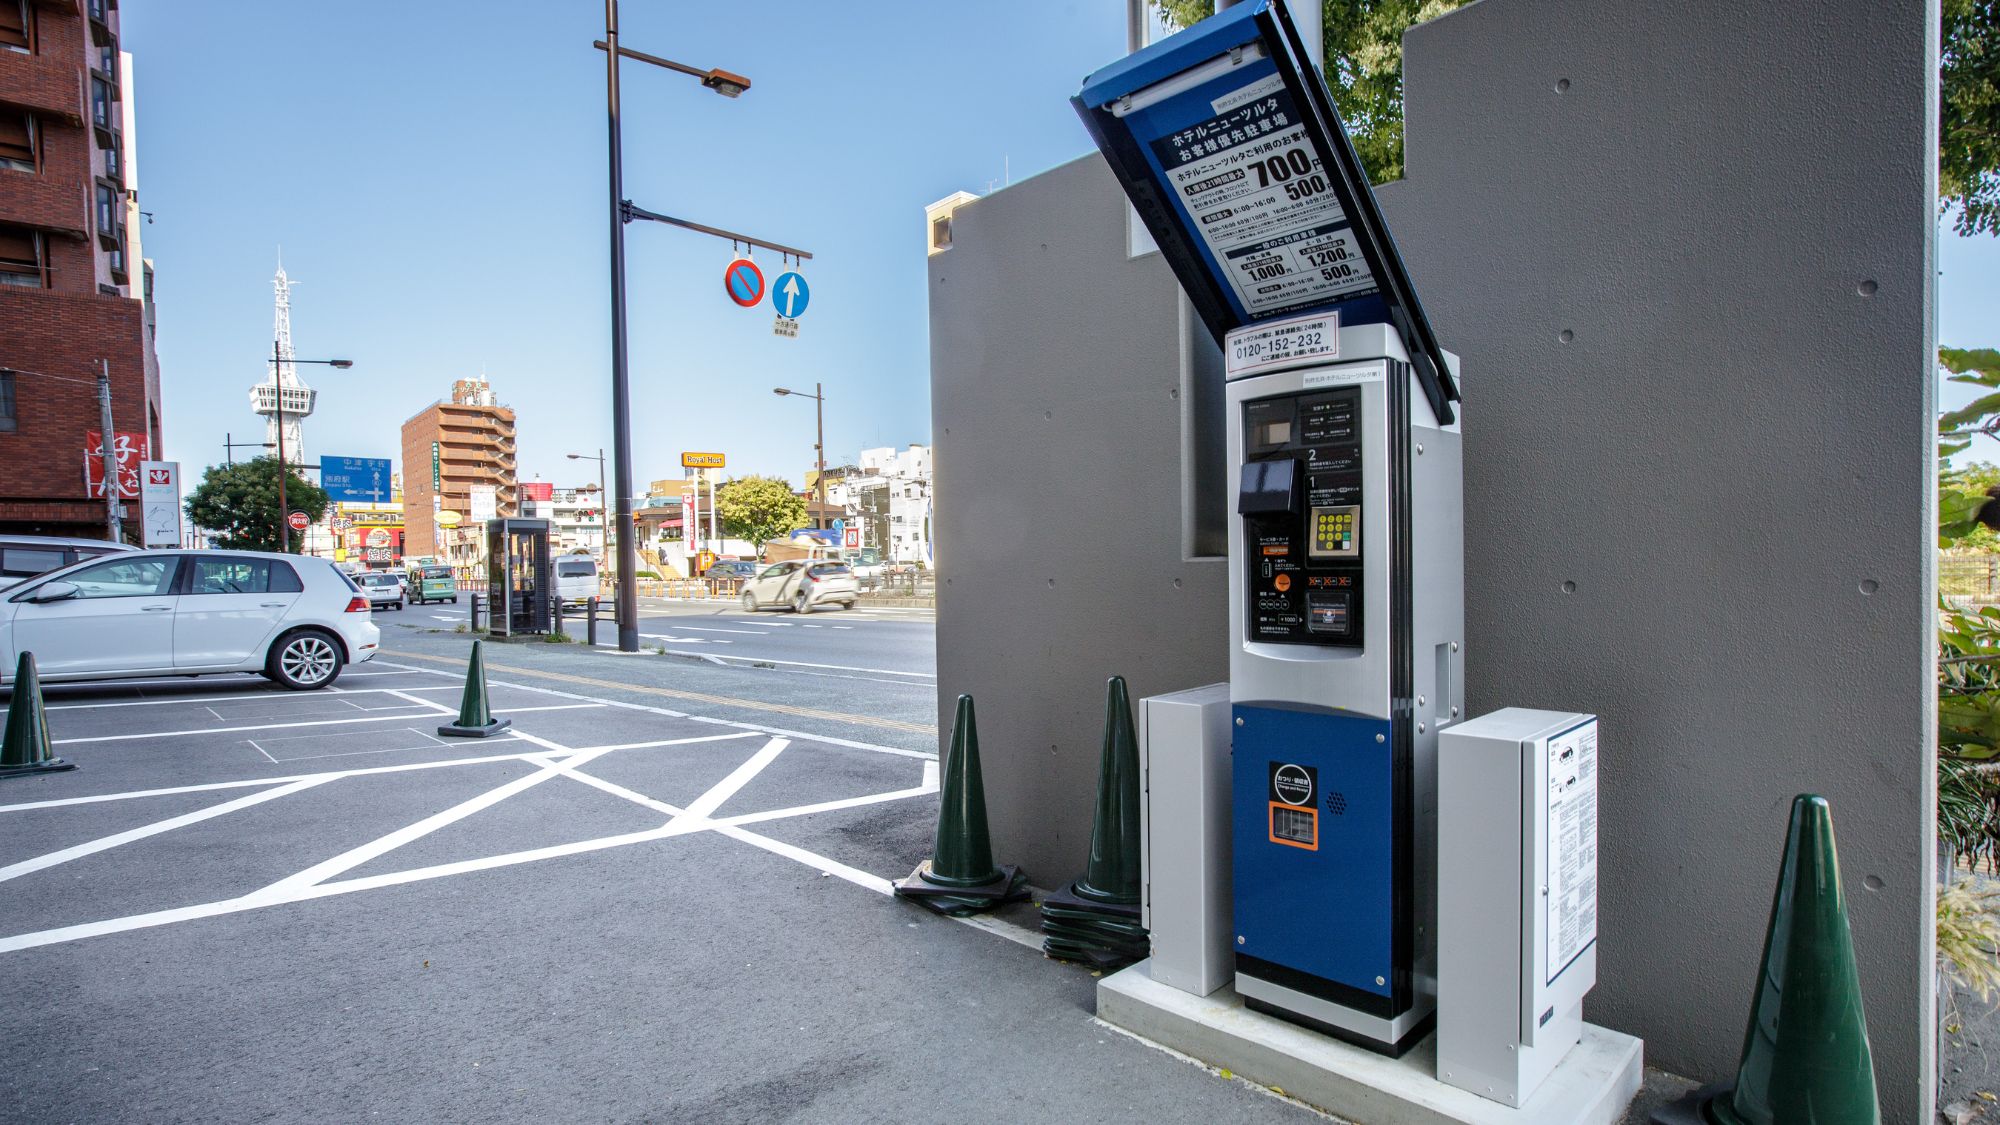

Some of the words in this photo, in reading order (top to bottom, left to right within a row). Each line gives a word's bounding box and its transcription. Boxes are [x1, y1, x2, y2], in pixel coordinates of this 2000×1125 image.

[1172, 97, 1279, 148] ホテルニューツルタ
[1179, 112, 1289, 162] お客様優先駐車場
[1307, 247, 1355, 267] 1,200円
[1248, 262, 1293, 282] 1,000円
[1321, 264, 1359, 281] 500円
[1236, 332, 1321, 359] 0120-152-232
[687, 456, 705, 464] Royal
[1309, 449, 1316, 461] 2
[1310, 476, 1315, 488] 1
[333, 519, 352, 528] 焼肉
[368, 549, 392, 560] 焼肉
[702, 556, 711, 567] P
